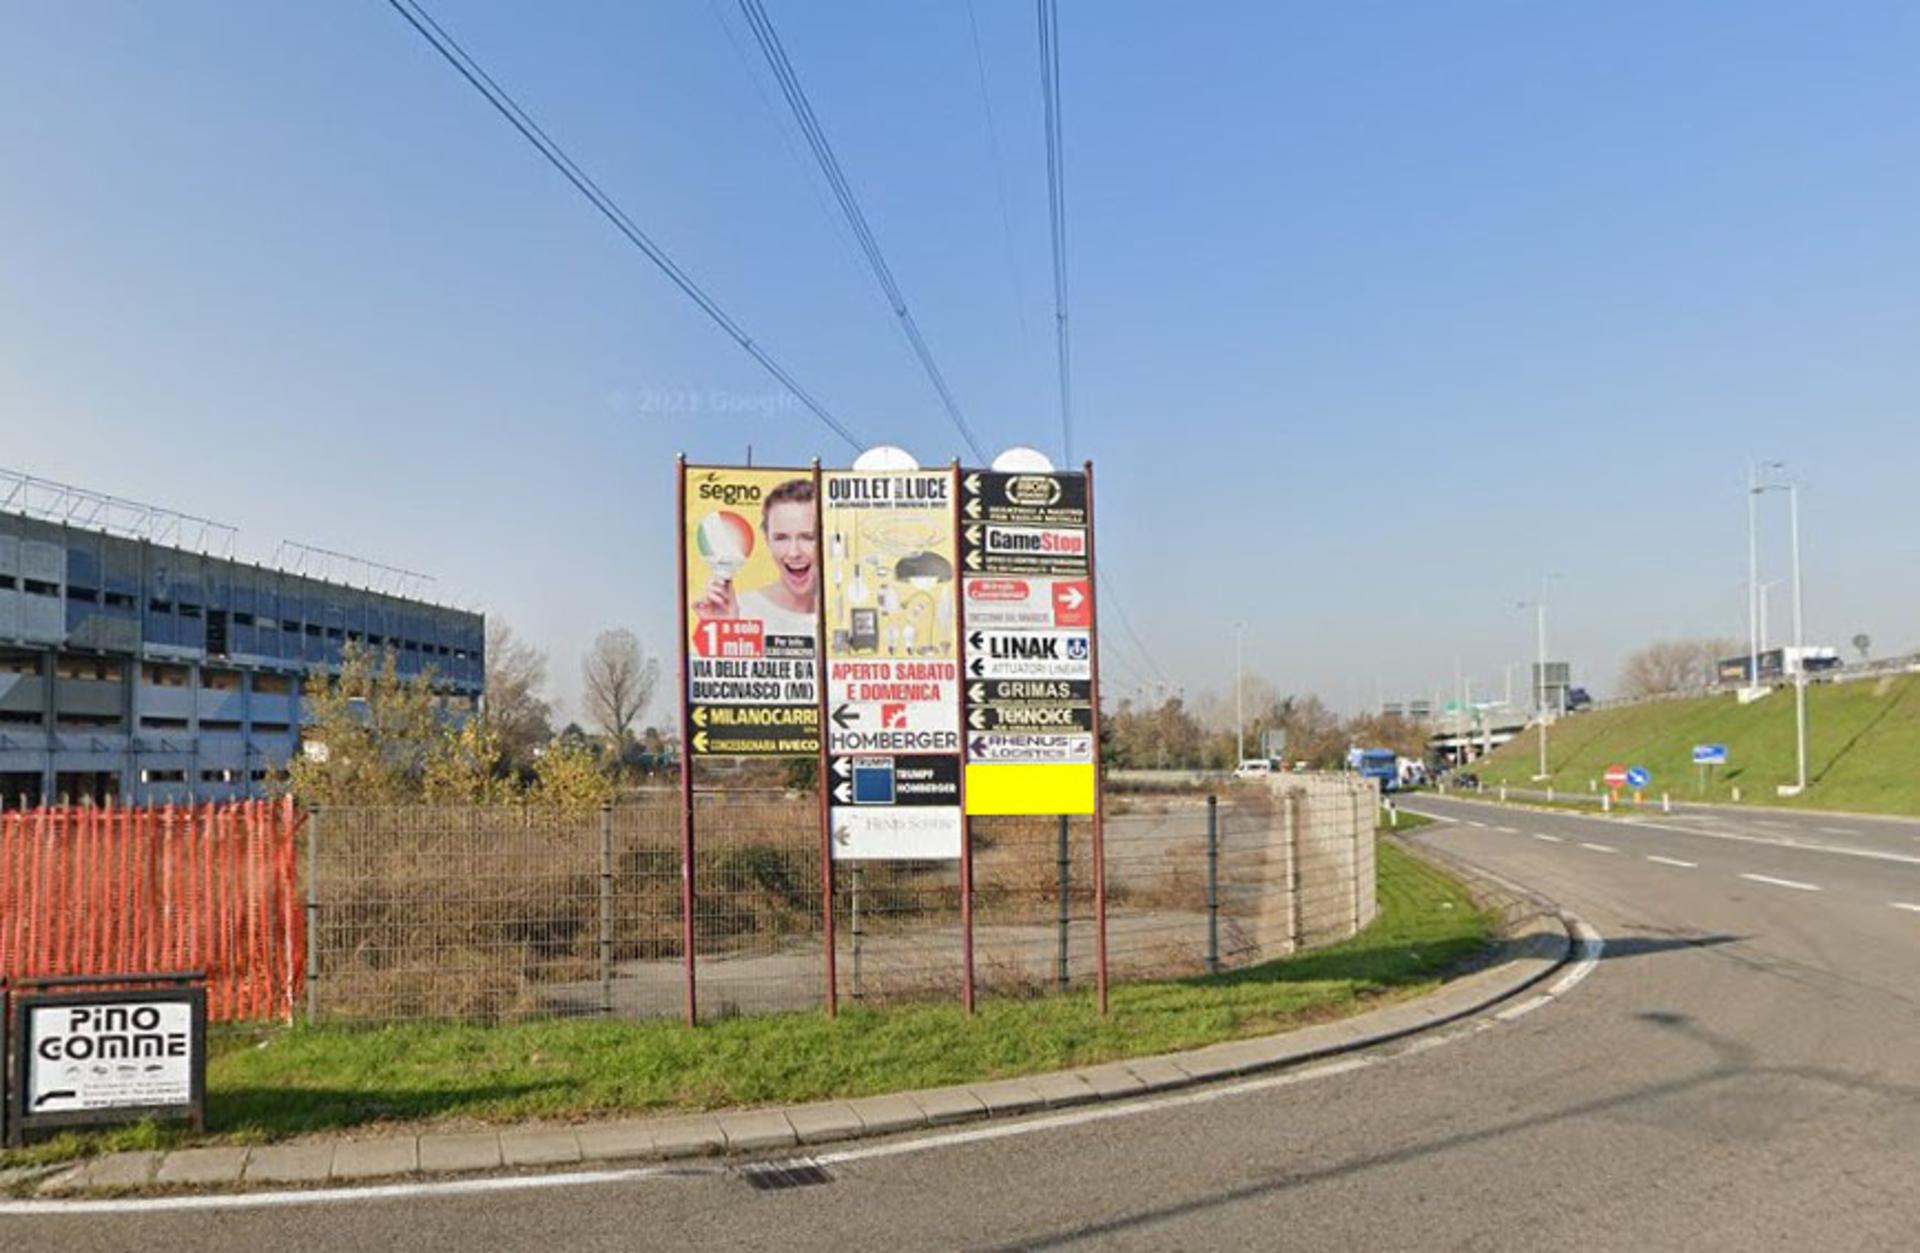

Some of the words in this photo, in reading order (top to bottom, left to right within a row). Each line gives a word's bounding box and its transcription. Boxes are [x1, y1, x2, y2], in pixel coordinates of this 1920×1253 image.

[699, 483, 761, 505] segno
[829, 478, 890, 499] OUTLET
[905, 478, 946, 499] LUCE
[990, 530, 1082, 552] GameStop
[703, 622, 717, 656] 1
[990, 637, 1058, 658] LINAK
[693, 660, 712, 678] VIA
[715, 661, 747, 678] DELLE
[751, 661, 791, 678] AZALEE
[832, 664, 890, 681] APERTO
[895, 664, 955, 681] SABATO
[693, 681, 781, 699] BUCCINASCO
[784, 681, 814, 701] (MI)
[846, 684, 856, 700] E
[860, 683, 941, 700] DOMENICA
[997, 682, 1070, 698] GRIMAS
[710, 708, 818, 725] MILANOCARRI
[778, 740, 819, 751] IVECO
[831, 732, 957, 749] HOMBERGER
[988, 736, 1068, 747] RHENUS
